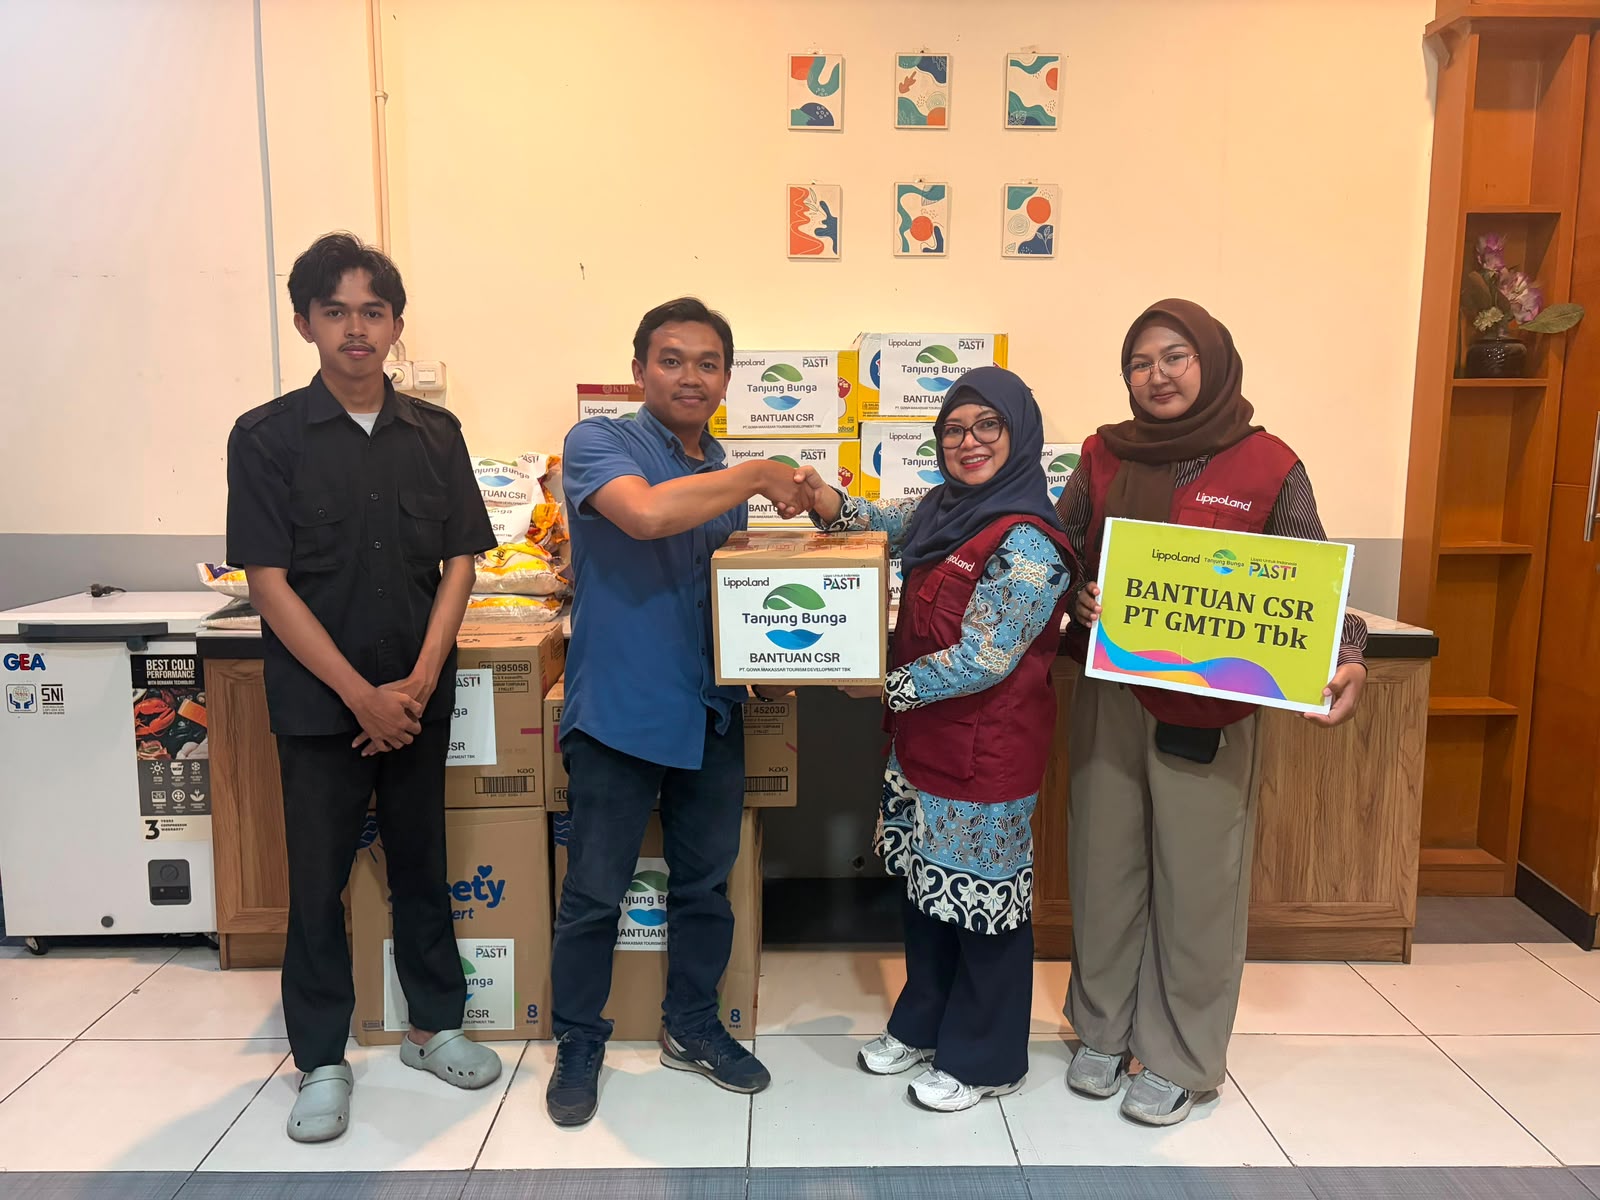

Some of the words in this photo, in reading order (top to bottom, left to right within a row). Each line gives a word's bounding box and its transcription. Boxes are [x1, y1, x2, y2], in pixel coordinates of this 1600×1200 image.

[901, 364, 939, 376] Tanjung
[941, 365, 972, 376] Bunga
[746, 384, 785, 395] Tanjung
[786, 383, 818, 394] Bunga
[750, 413, 795, 423] BANTUAN
[795, 413, 815, 422] CSR
[902, 457, 939, 468] Tanjung
[502, 466, 530, 480] Bunga
[508, 491, 527, 500] CSR
[903, 487, 930, 495] BANT
[1204, 557, 1226, 566] Tanjung
[1226, 560, 1245, 568] Bunga
[1124, 577, 1256, 614] BANTUAN
[1262, 595, 1315, 623] CSR
[741, 612, 799, 627] Tanjung
[801, 611, 847, 626] Bunga
[1122, 604, 1159, 628] PT
[1164, 611, 1246, 640] GMTD
[1253, 622, 1309, 650] Tbk
[3, 652, 47, 671] GEA
[749, 652, 812, 663] BANTUAN
[814, 652, 841, 663] CSR
[145, 659, 169, 671] BEST
[171, 659, 195, 671] COLD
[495, 663, 529, 673] 995058
[146, 670, 196, 679] PERFORMANCE
[41, 687, 64, 702] SNI
[753, 705, 786, 715] 452030
[144, 819, 161, 840] 3
[617, 928, 666, 938] ANTUAN
[466, 1009, 490, 1018] CSR
[527, 1003, 538, 1019] 8
[730, 1007, 741, 1023] 8
